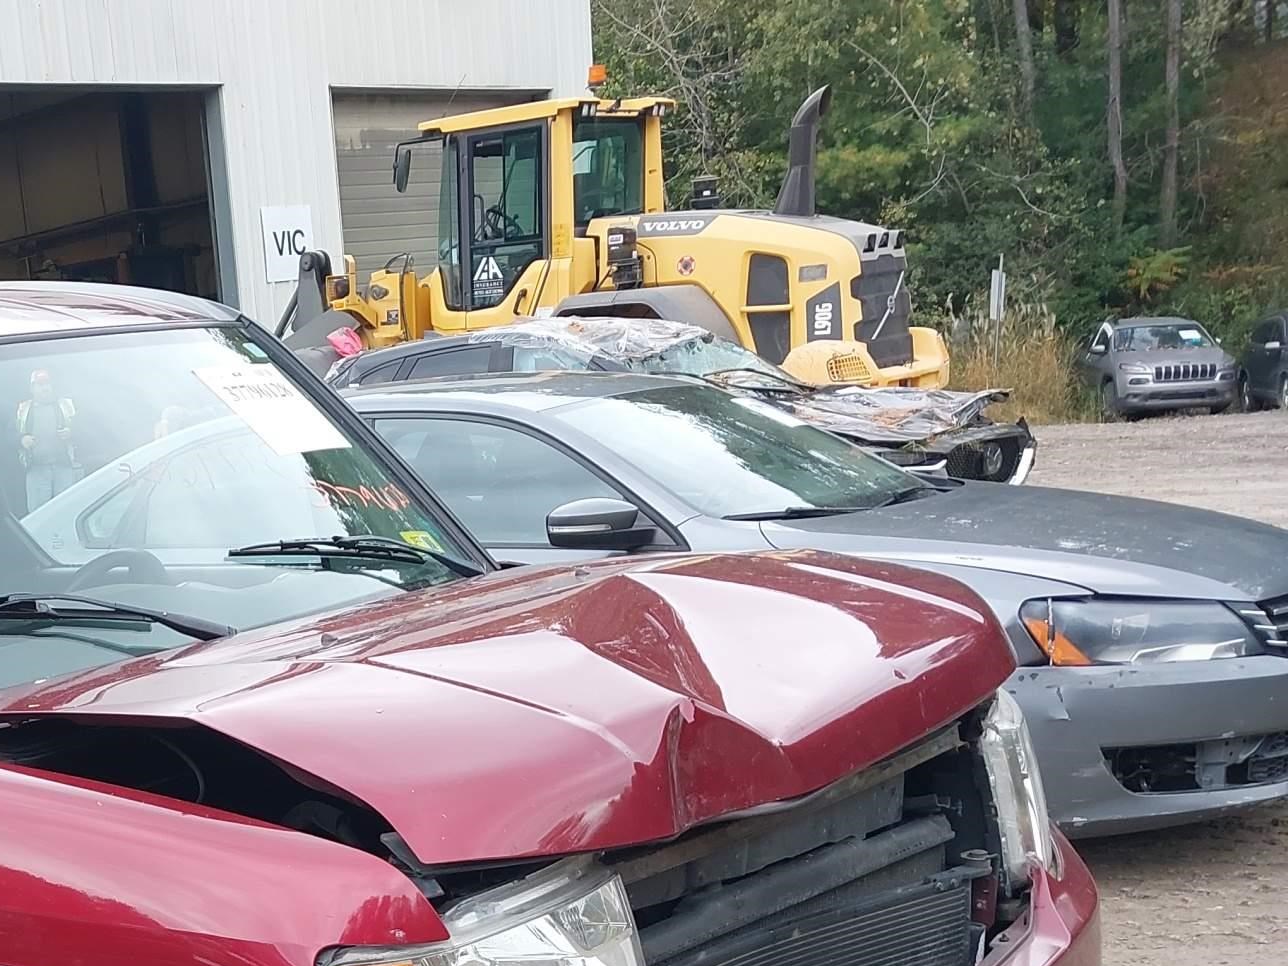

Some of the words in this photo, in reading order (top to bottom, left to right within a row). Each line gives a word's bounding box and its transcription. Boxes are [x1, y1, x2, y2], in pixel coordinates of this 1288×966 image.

[643, 220, 705, 232] VOLVO
[272, 229, 306, 256] VIC
[814, 302, 832, 336] L90G
